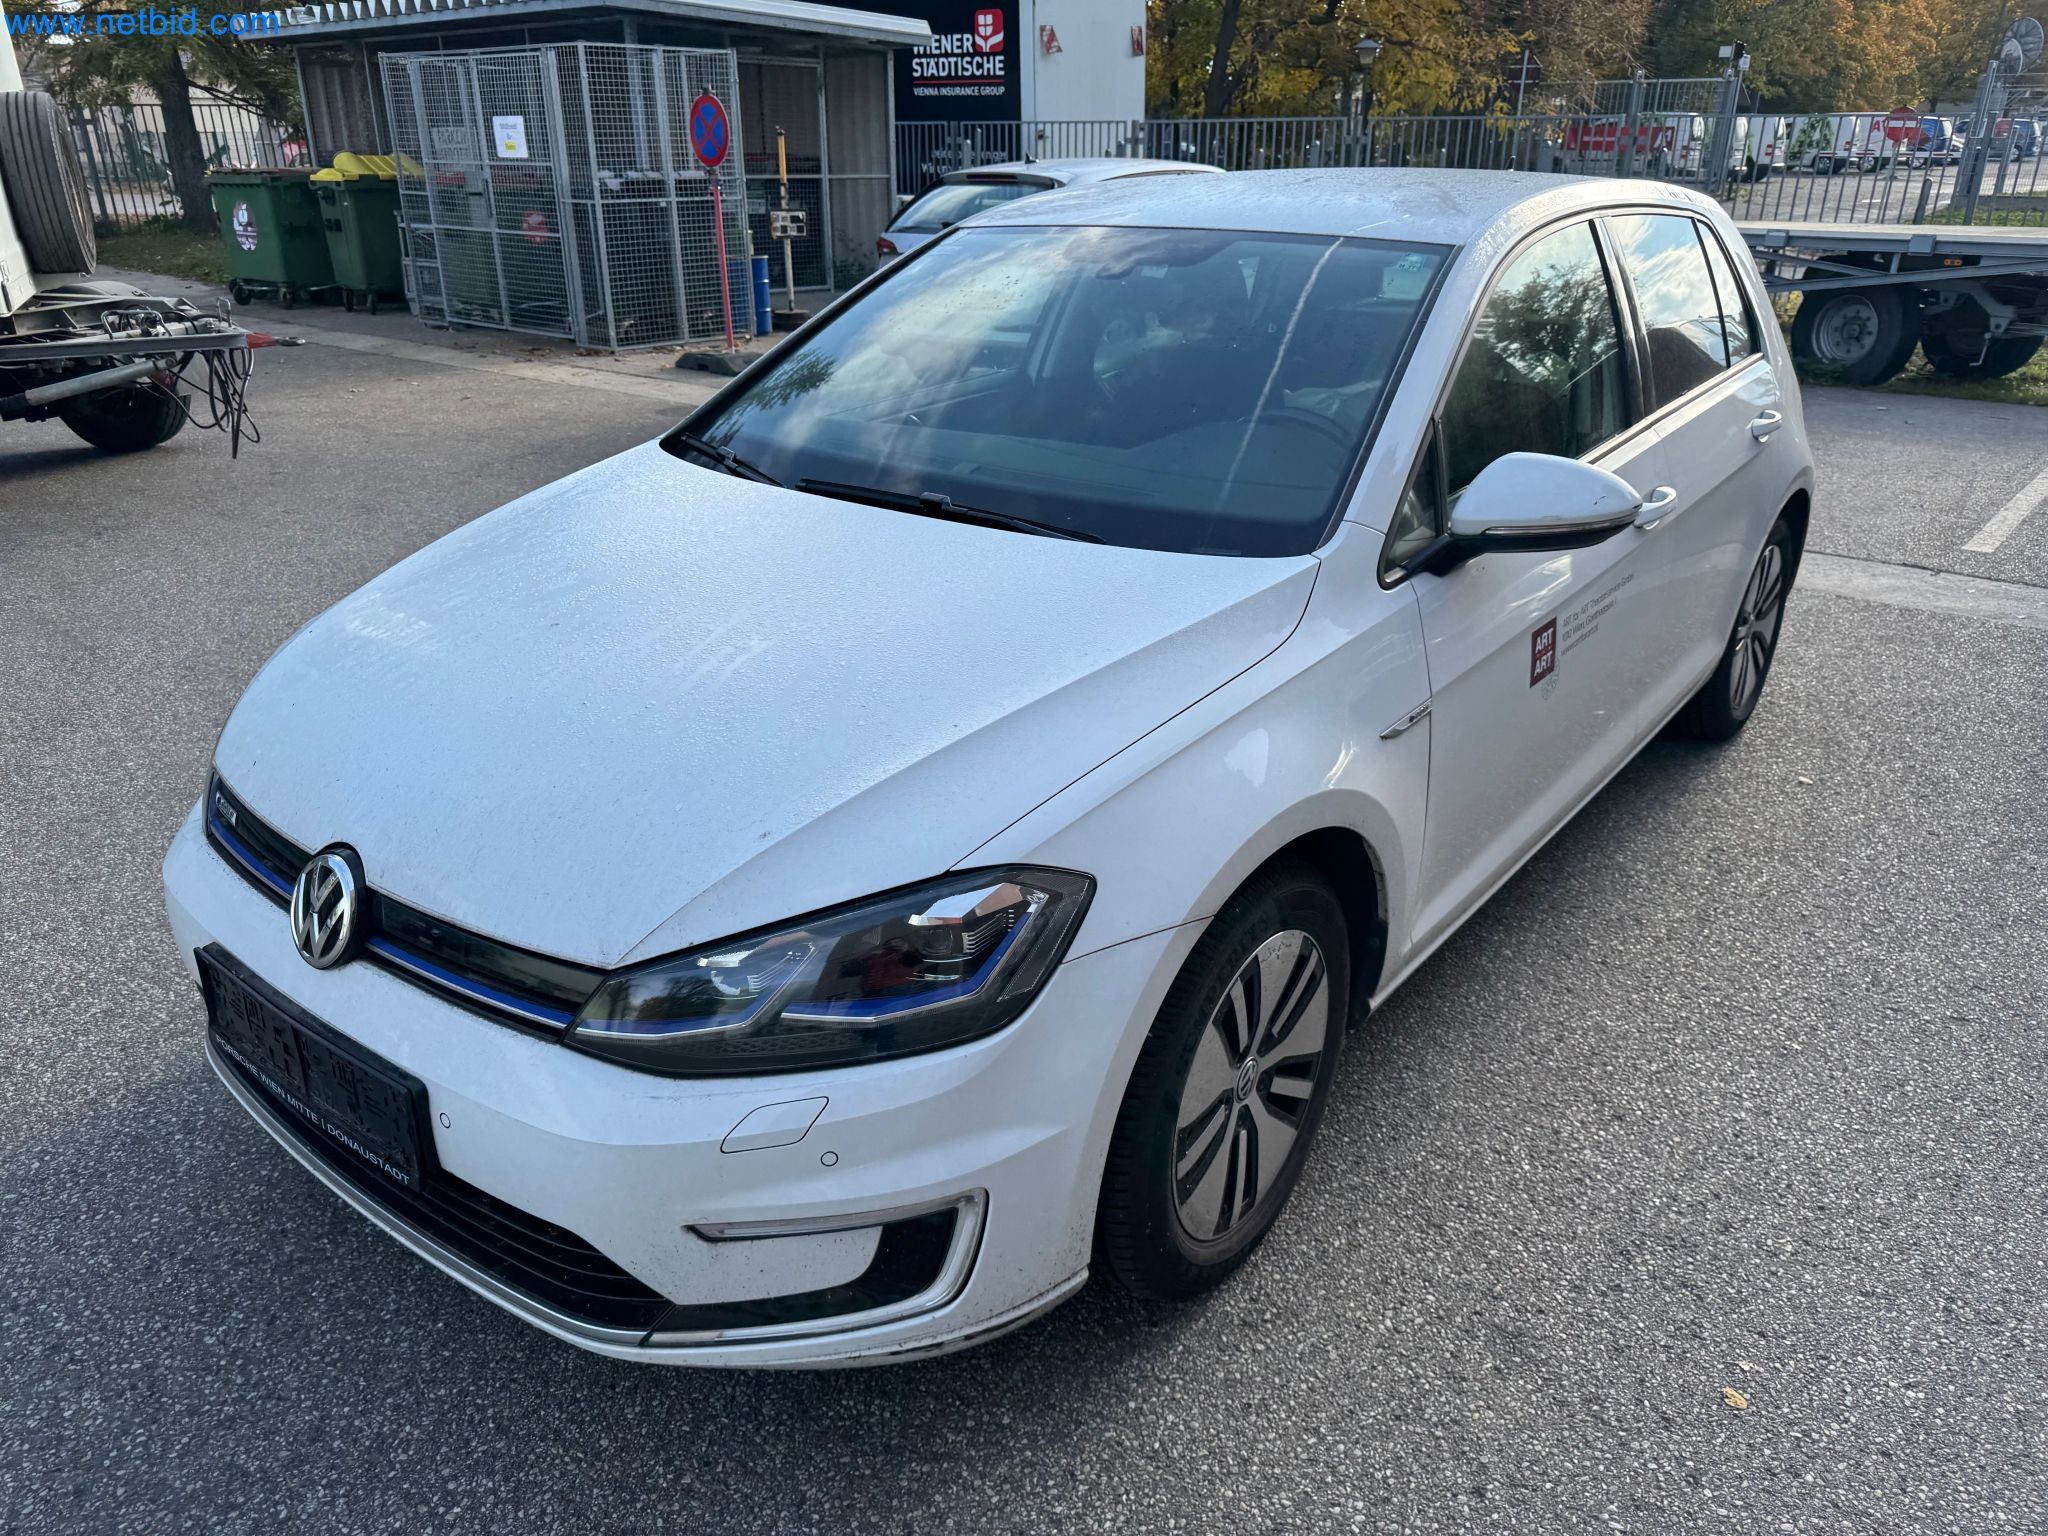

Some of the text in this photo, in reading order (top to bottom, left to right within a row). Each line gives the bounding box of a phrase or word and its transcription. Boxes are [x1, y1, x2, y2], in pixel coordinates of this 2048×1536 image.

[912, 55, 1005, 77] STÄDTISCHE
[913, 86, 1005, 96] VIENNA INSURANCE GROUP
[1535, 627, 1554, 654] ART
[1534, 650, 1553, 677] ART
[215, 1034, 260, 1077] PORSCHE
[259, 1071, 286, 1099] WIEN
[287, 1092, 319, 1126] MITTE
[327, 1123, 410, 1186] DONAUSTADT
